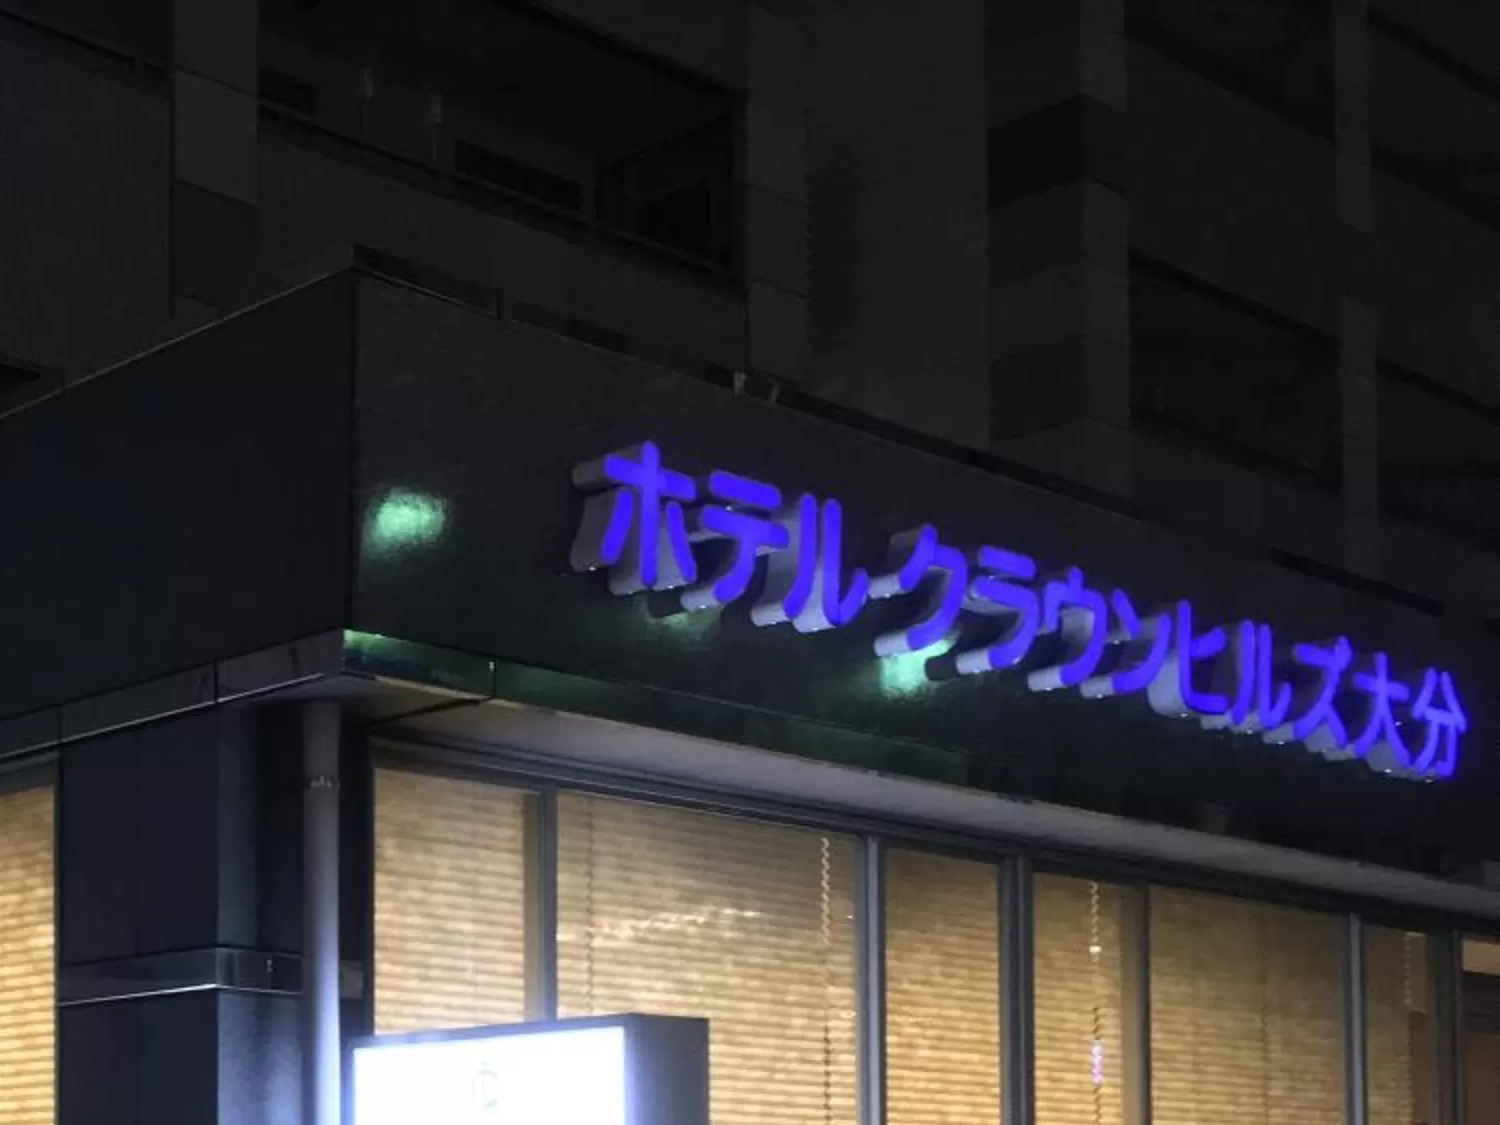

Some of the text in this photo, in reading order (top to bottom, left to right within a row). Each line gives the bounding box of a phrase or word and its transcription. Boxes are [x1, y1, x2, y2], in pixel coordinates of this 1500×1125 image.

[600, 441, 1468, 781] ホテル クラウンヒルズ大分
